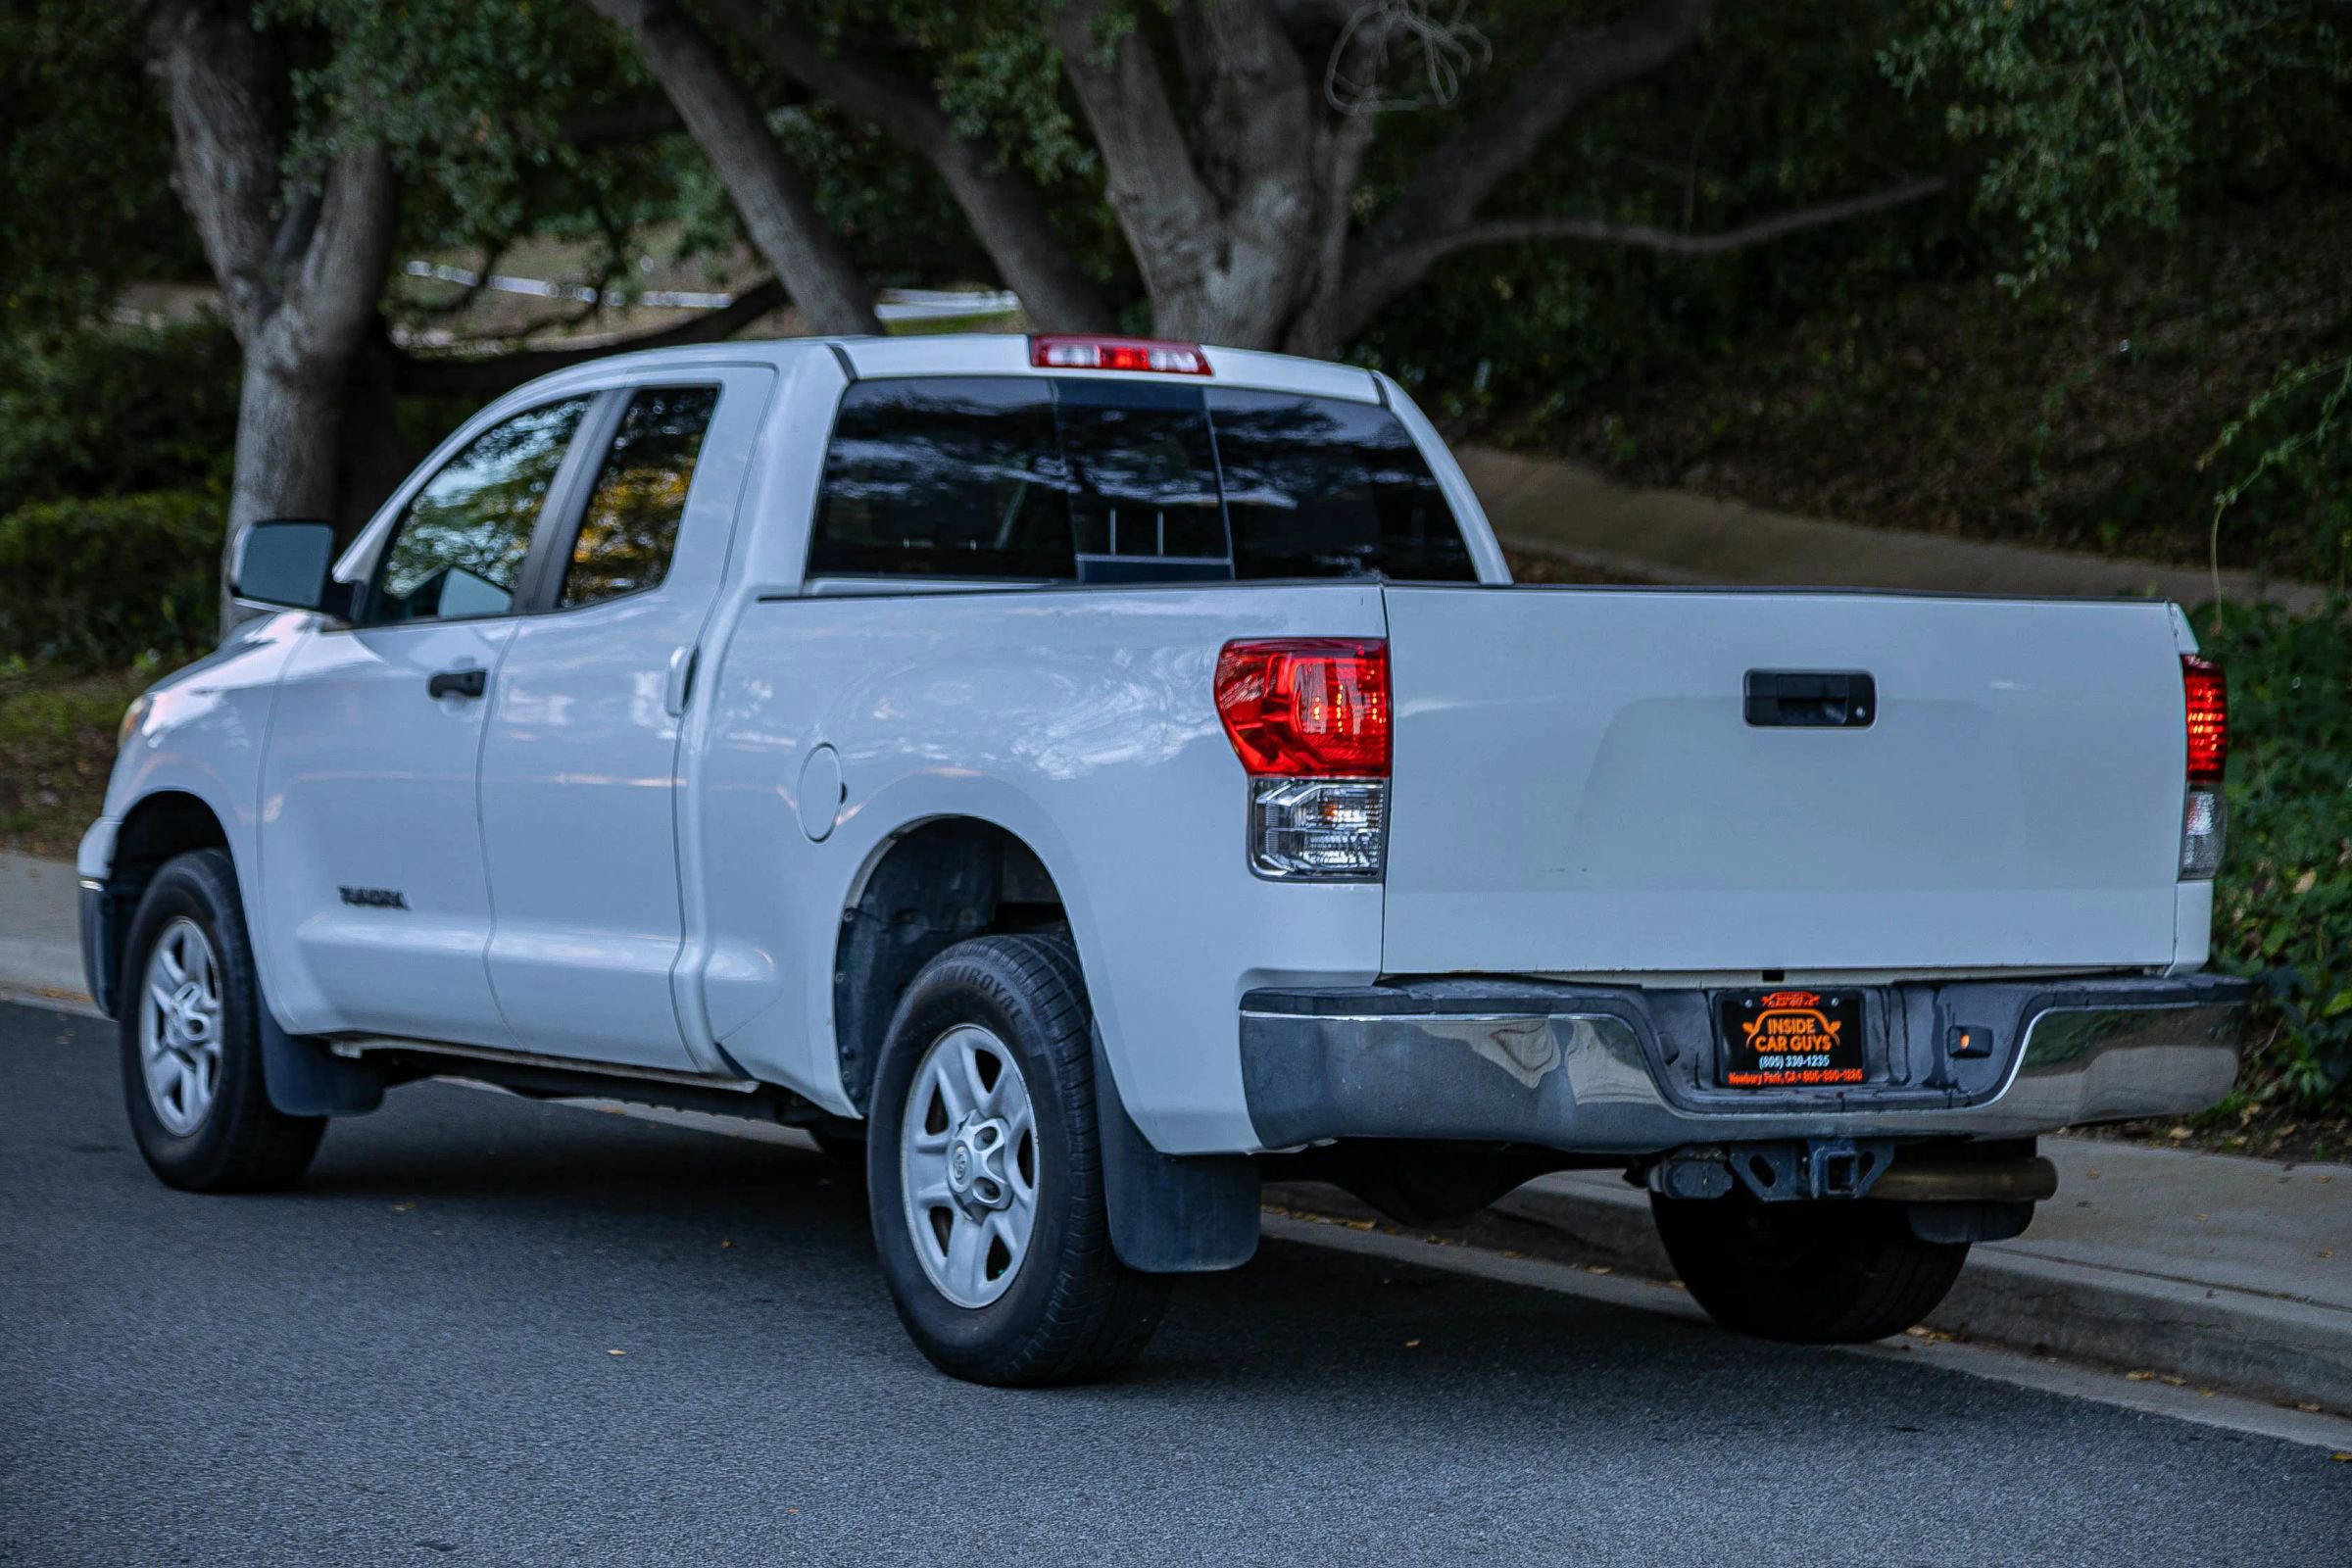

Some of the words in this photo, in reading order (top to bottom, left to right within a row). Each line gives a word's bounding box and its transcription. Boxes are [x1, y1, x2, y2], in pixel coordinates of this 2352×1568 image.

[1767, 1017, 1816, 1035] INSIDE
[1755, 1035, 1788, 1053] CAR
[1789, 1034, 1832, 1052] GUYS
[1759, 1055, 1784, 1070] (805)
[1786, 1054, 1830, 1068] 330-1235
